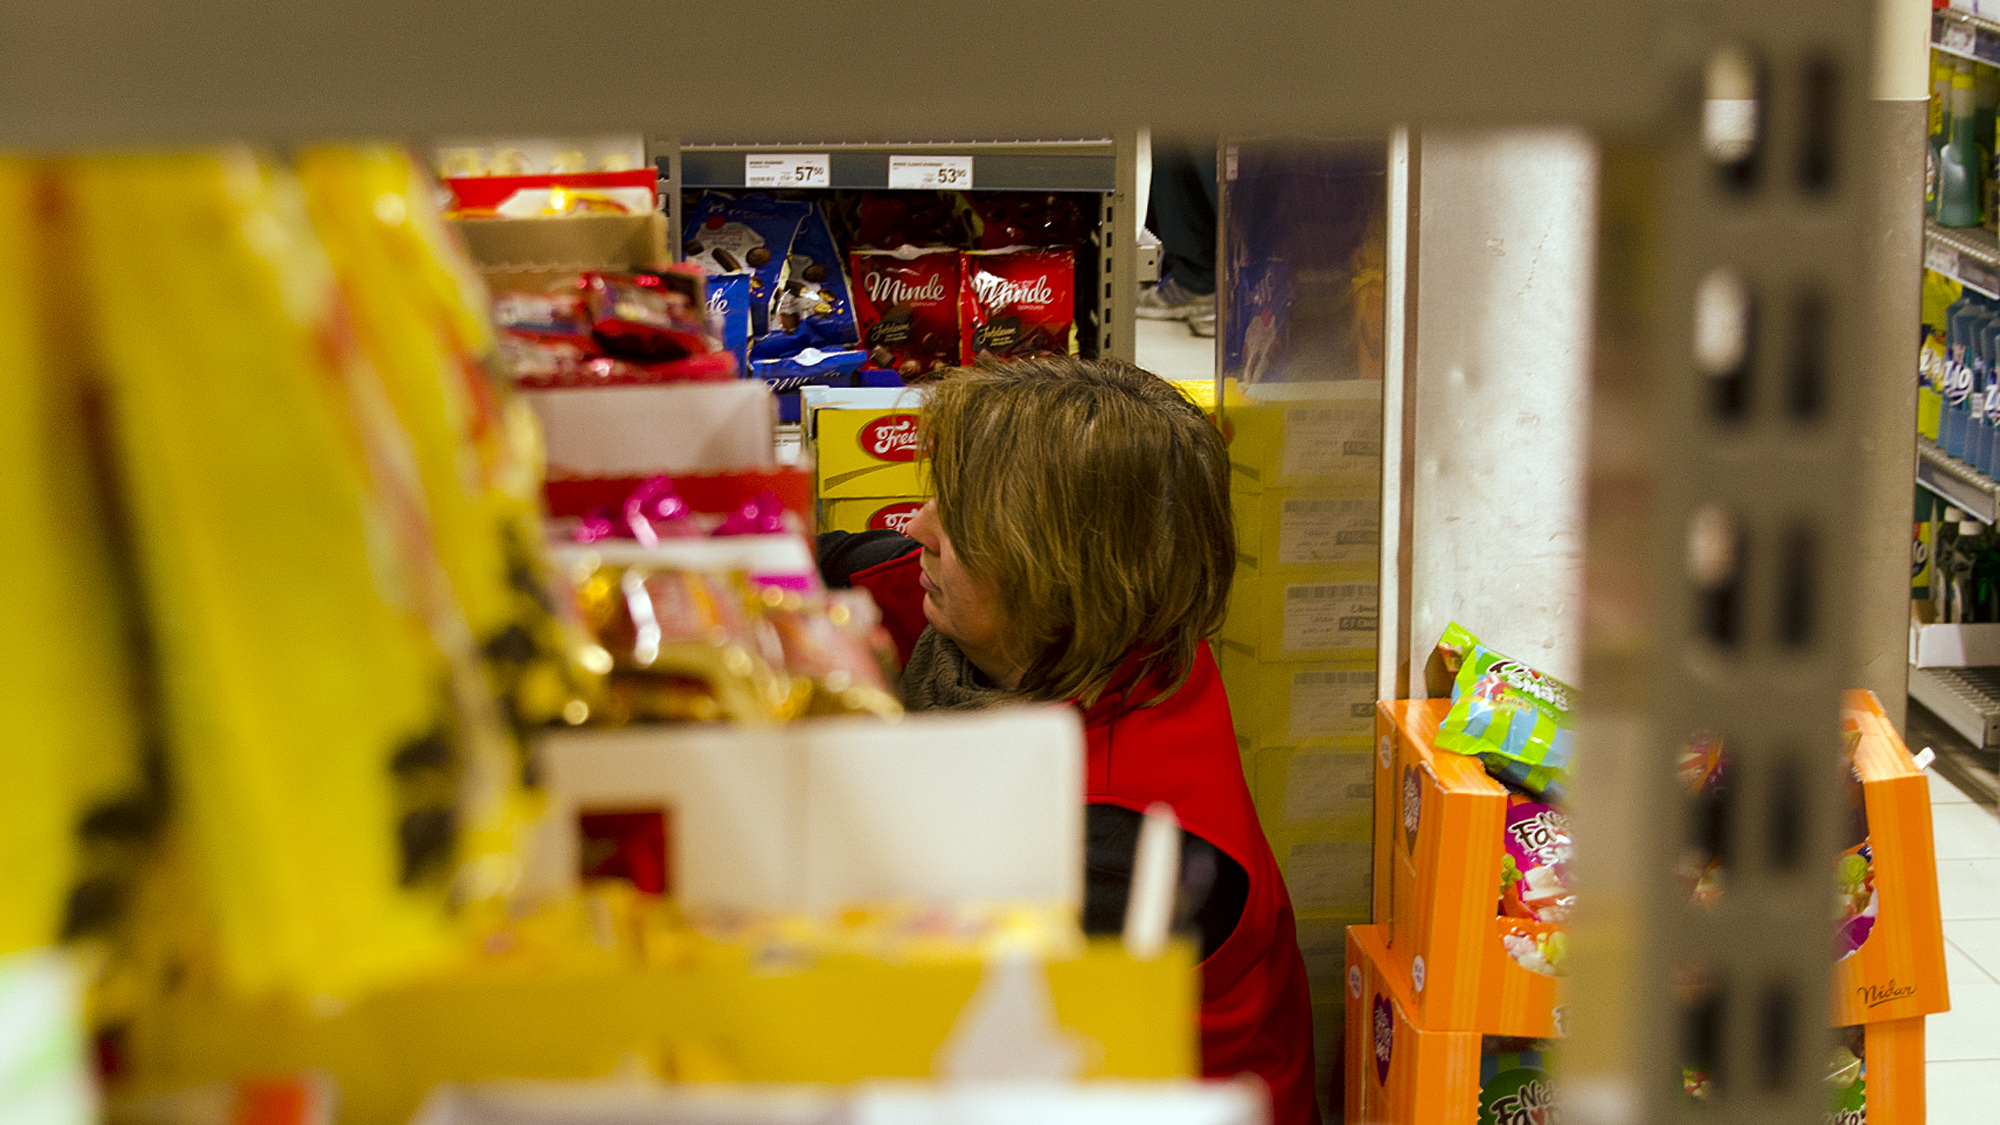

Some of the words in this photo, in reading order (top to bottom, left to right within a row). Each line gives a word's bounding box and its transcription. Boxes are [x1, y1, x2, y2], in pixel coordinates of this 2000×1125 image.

[863, 271, 947, 306] Minde
[874, 420, 918, 454] Frei
[1857, 979, 1918, 1005] Nidar
